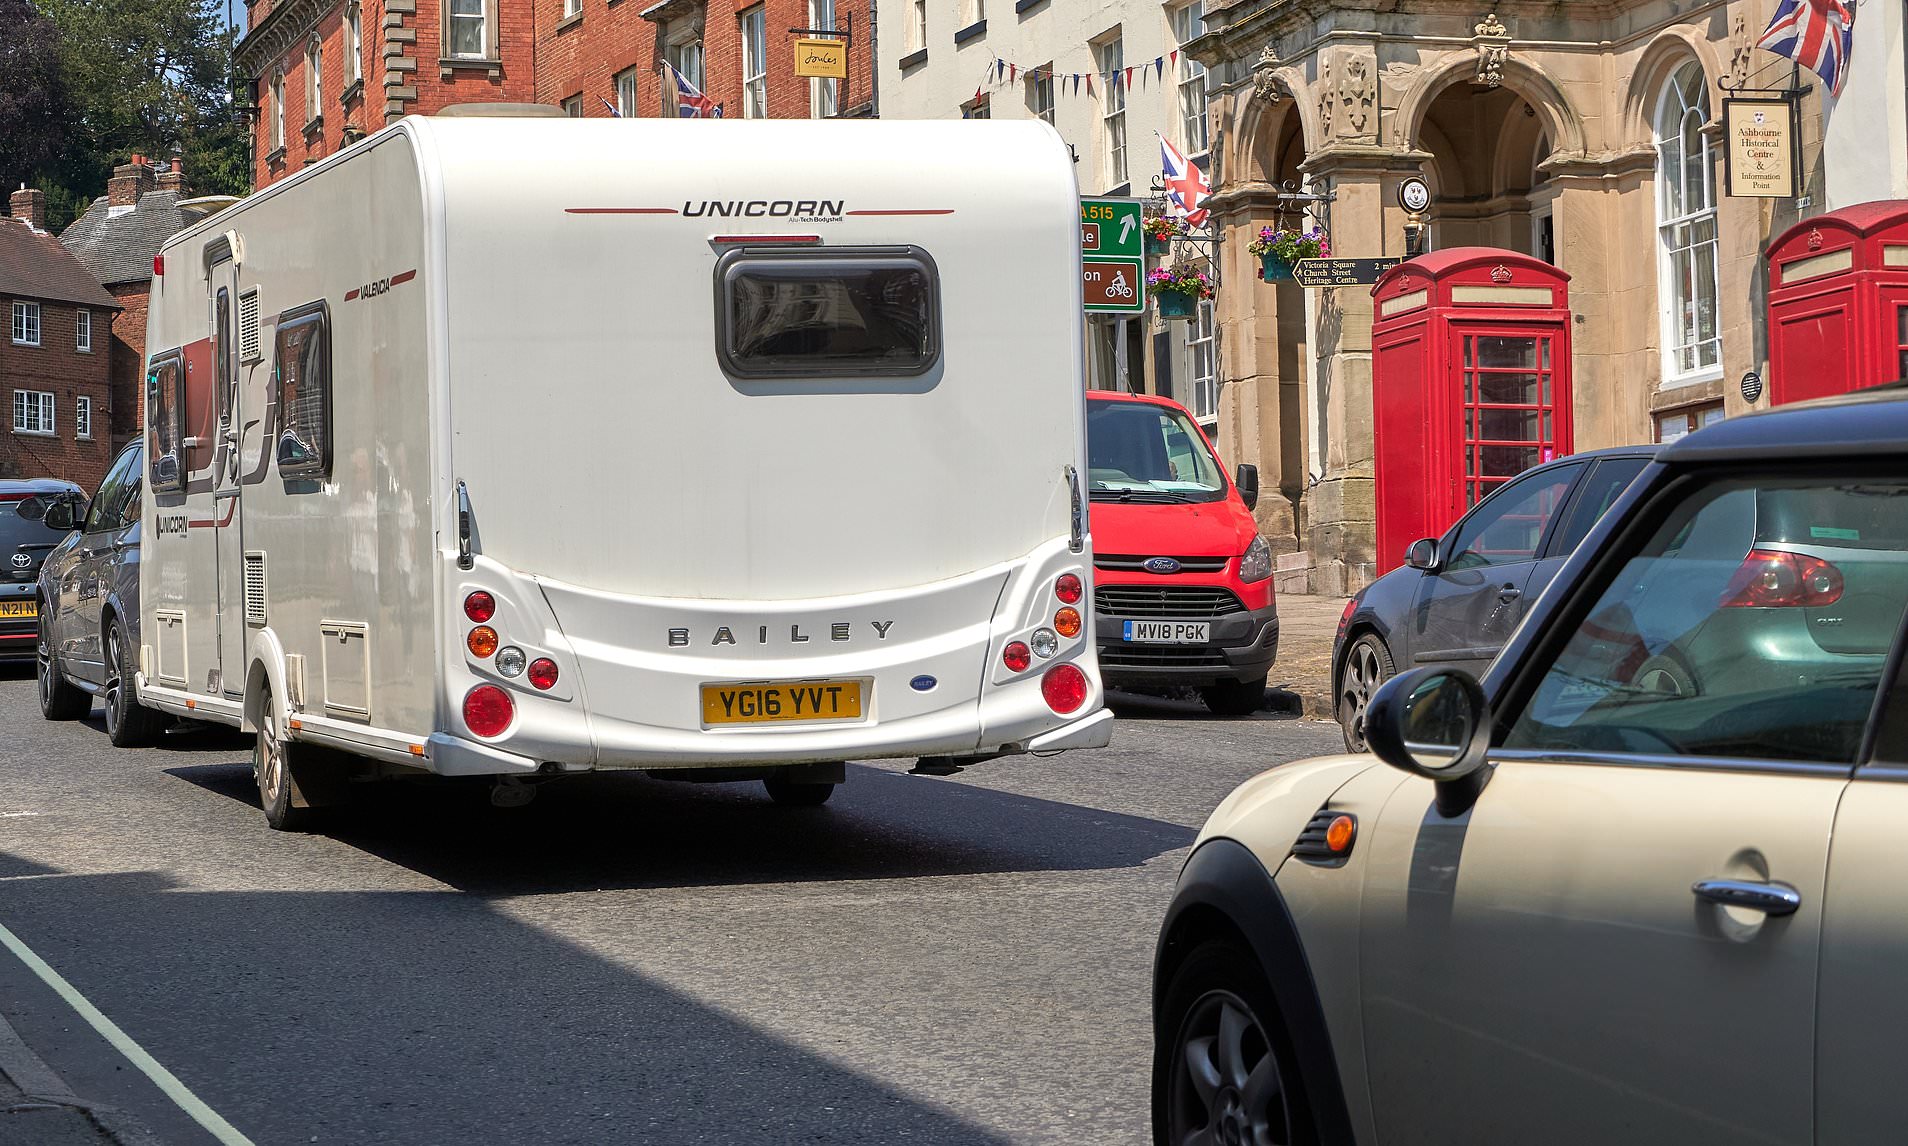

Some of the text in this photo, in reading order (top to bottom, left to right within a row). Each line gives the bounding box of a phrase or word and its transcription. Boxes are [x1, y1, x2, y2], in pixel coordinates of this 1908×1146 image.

[1738, 128, 1782, 137] Ashbourne
[1741, 138, 1779, 148] Historical
[1747, 149, 1774, 158] Centre
[1756, 161, 1764, 170] &
[1741, 172, 1781, 180] Information
[1752, 181, 1770, 189] Point
[682, 200, 845, 217] UNICORN
[1082, 229, 1094, 242] le
[1303, 261, 1329, 269] Victoria
[1332, 261, 1356, 271] Square
[1374, 262, 1380, 270] 2
[1084, 271, 1101, 281] on
[1303, 269, 1328, 277] Church
[1303, 277, 1332, 285] Heritage
[1335, 276, 1358, 284] Centre
[360, 277, 390, 300] VALENCIA
[1153, 559, 1174, 570] Ford
[0, 602, 37, 615] N21 N
[668, 620, 894, 647] BAILEY
[1137, 624, 1205, 639] MV18 PGK
[720, 687, 842, 717] YG16 YVT
